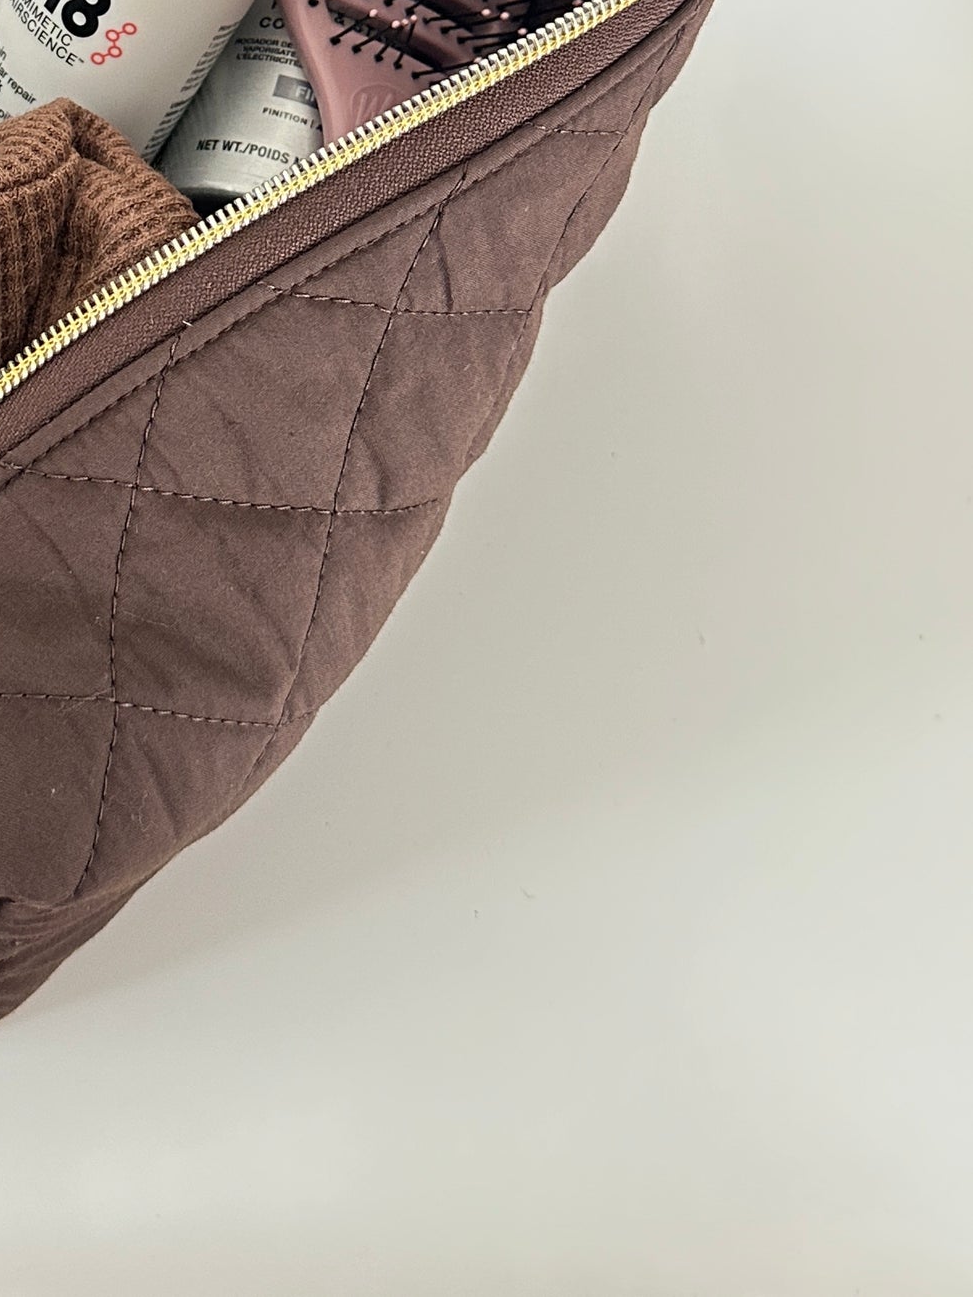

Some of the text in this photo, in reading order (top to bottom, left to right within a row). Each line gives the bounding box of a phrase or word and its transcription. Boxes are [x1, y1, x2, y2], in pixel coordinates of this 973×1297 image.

[7, 77, 37, 104] repair
[262, 106, 308, 125] FINITION
[196, 139, 219, 151] NET
[222, 139, 290, 164] WT./POIDS
